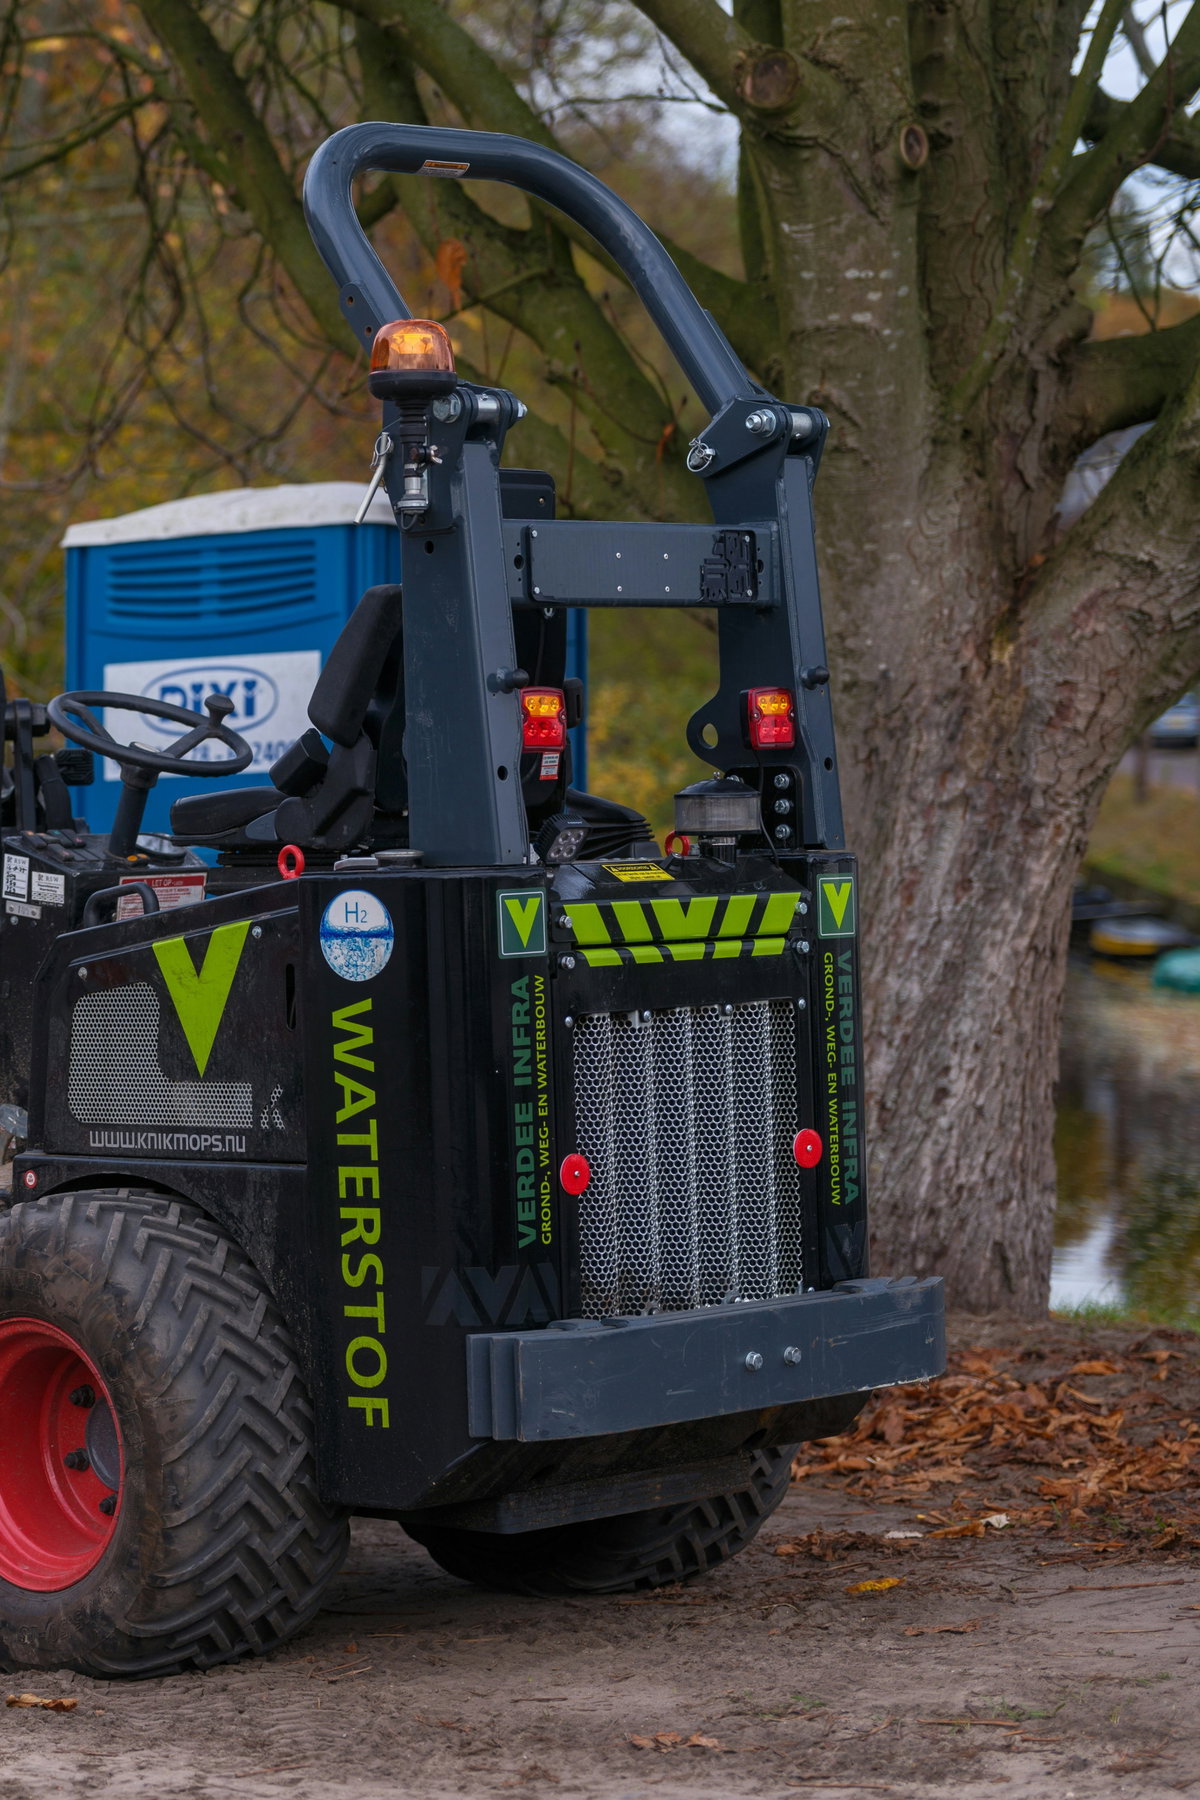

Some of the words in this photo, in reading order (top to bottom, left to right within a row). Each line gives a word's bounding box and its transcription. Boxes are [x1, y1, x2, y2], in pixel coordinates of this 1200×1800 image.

[345, 902, 368, 923] H2
[511, 975, 533, 1086] INFRA
[823, 952, 835, 1022] GROND-,
[837, 950, 856, 1086] VERDEE
[534, 975, 548, 1090] WATERBOUW
[826, 1025, 837, 1069] WEG-
[538, 1094, 549, 1116] EN
[827, 1072, 838, 1094] EN
[514, 1102, 538, 1249] VERDEE
[538, 1121, 550, 1168] WEG-
[829, 1098, 842, 1205] WATERBOUW
[841, 1101, 860, 1205] INFRA
[331, 998, 391, 1429] WATERSTOF
[540, 1171, 552, 1245] GROND-,
